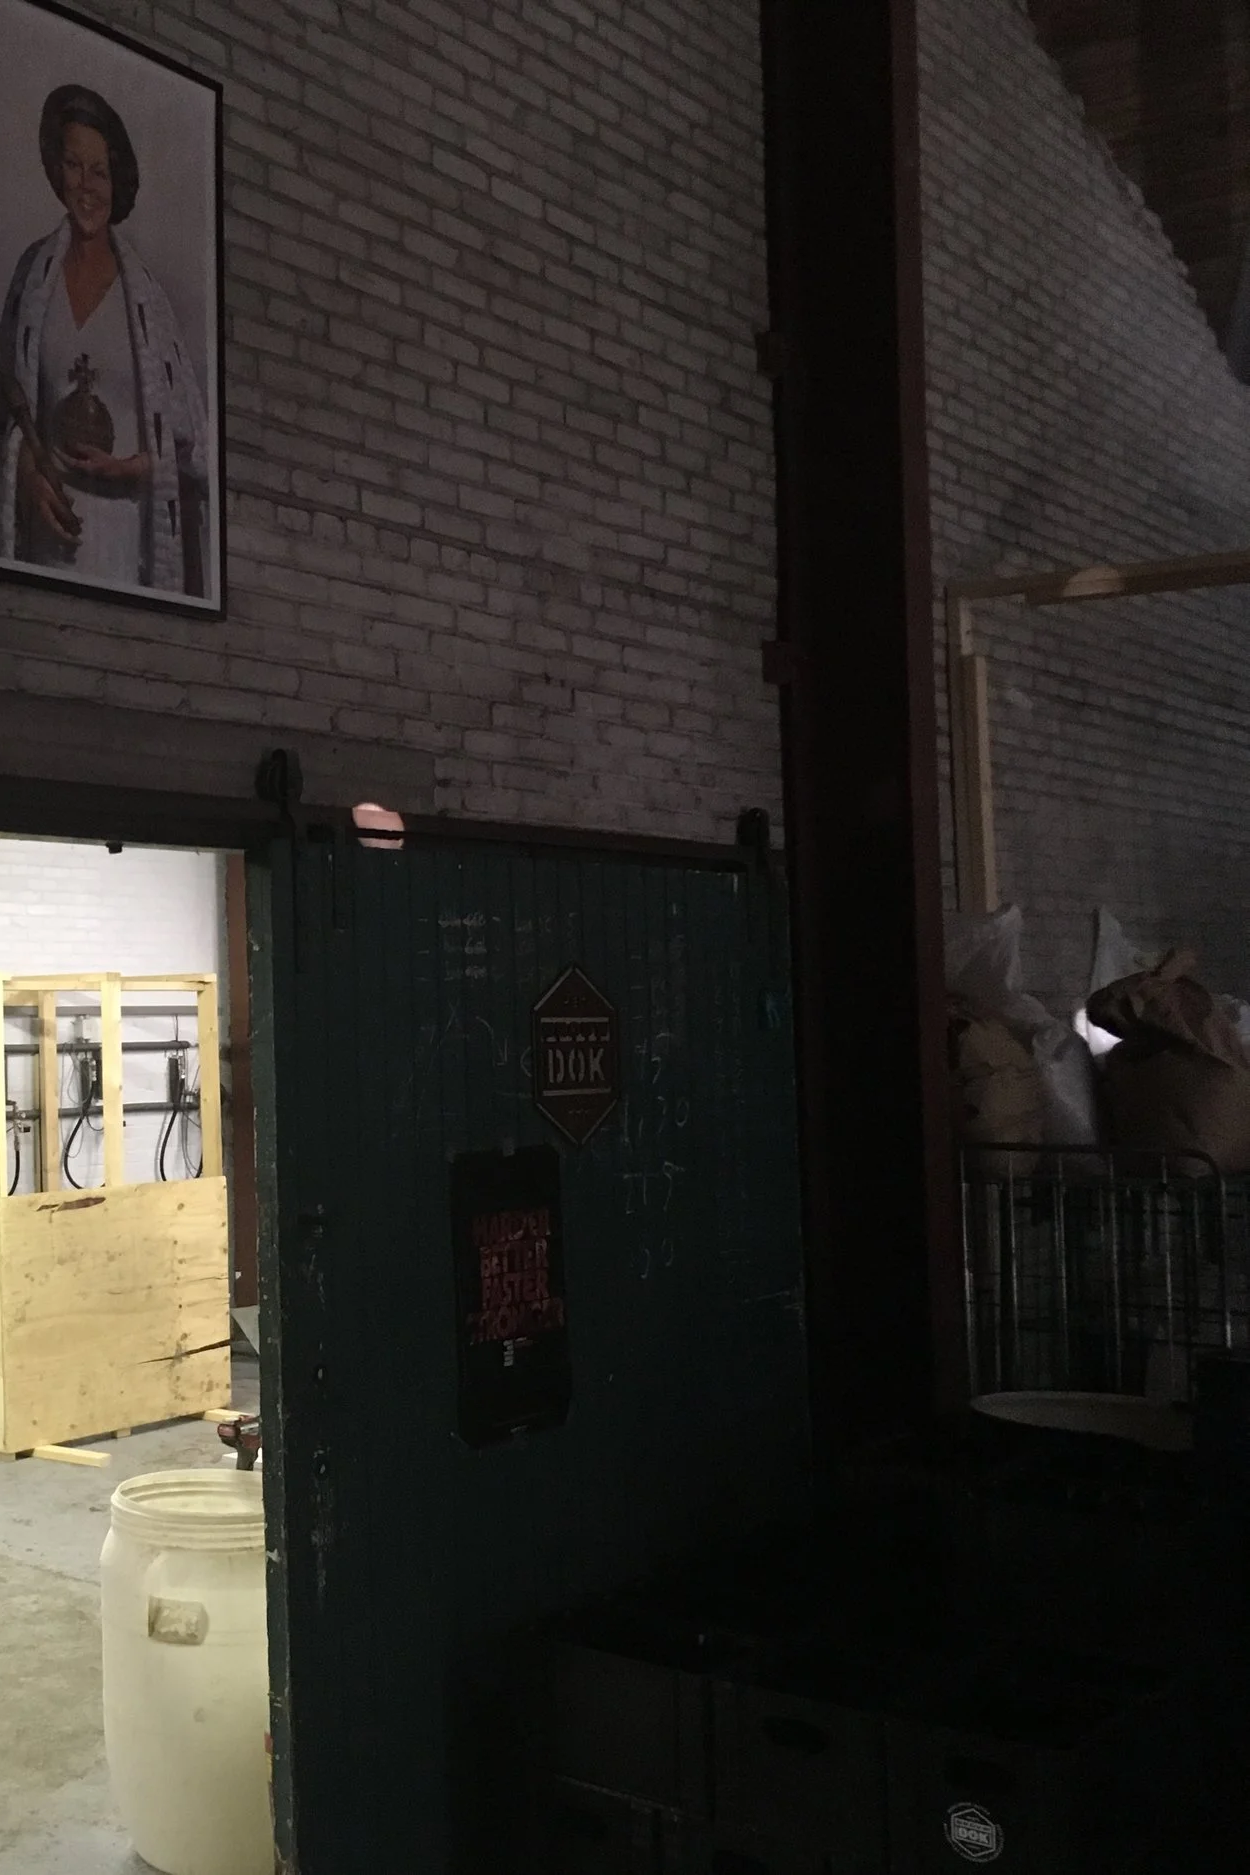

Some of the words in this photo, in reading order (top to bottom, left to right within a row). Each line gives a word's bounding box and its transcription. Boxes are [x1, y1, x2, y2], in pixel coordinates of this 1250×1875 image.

[547, 1047, 606, 1084] DOK
[479, 1239, 550, 1278] BETTER
[481, 1270, 550, 1310] FASTER
[958, 1827, 989, 1844] DOK
